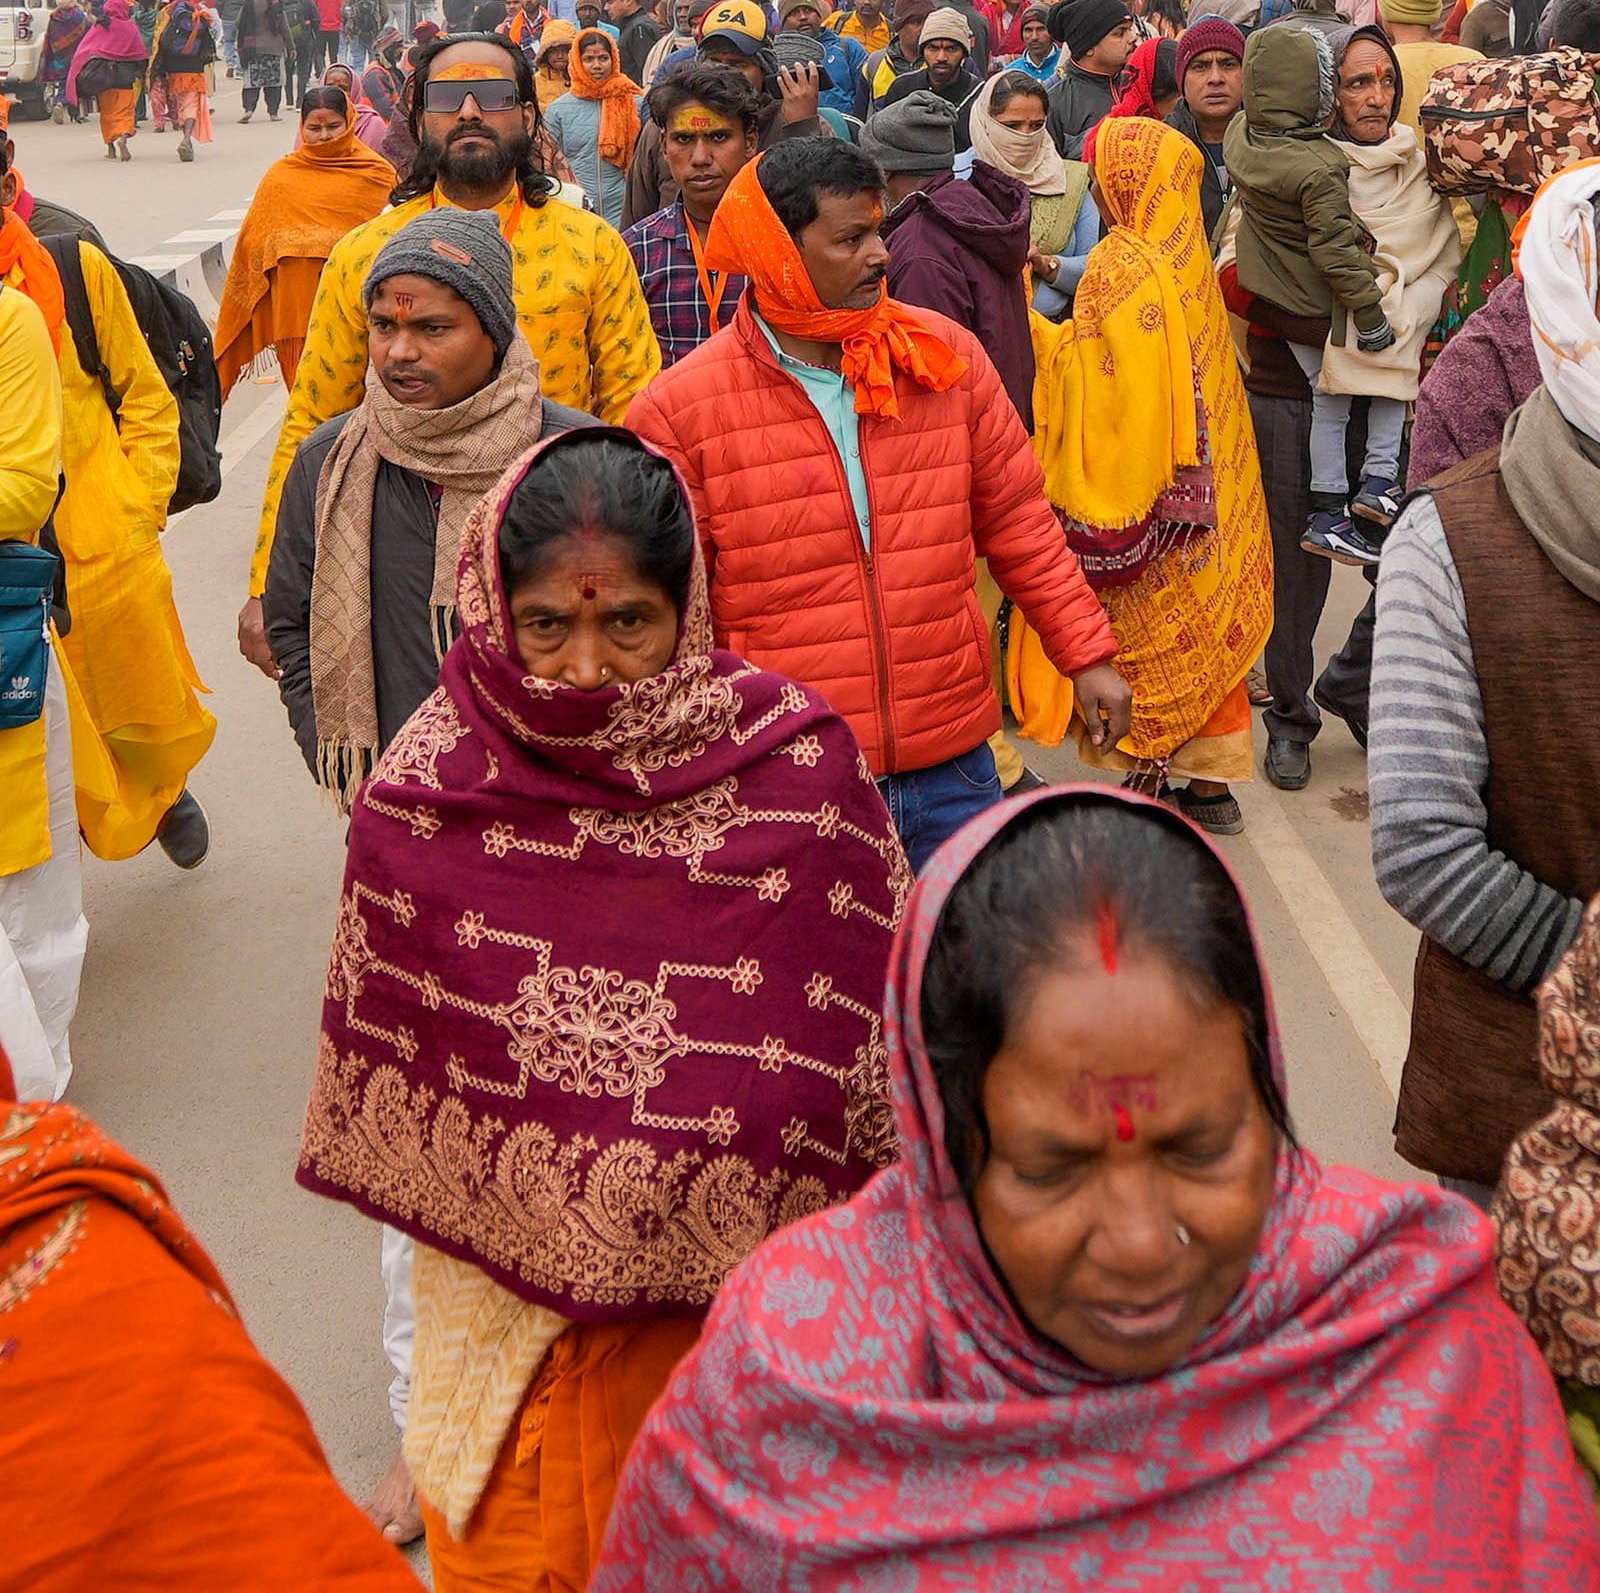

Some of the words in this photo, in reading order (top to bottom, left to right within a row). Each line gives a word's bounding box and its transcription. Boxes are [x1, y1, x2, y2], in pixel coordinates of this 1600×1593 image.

[717, 9, 746, 26] SA
[1160, 212, 1192, 256] सीताराम
[783, 261, 795, 284] राम
[1, 690, 38, 700] adidas
